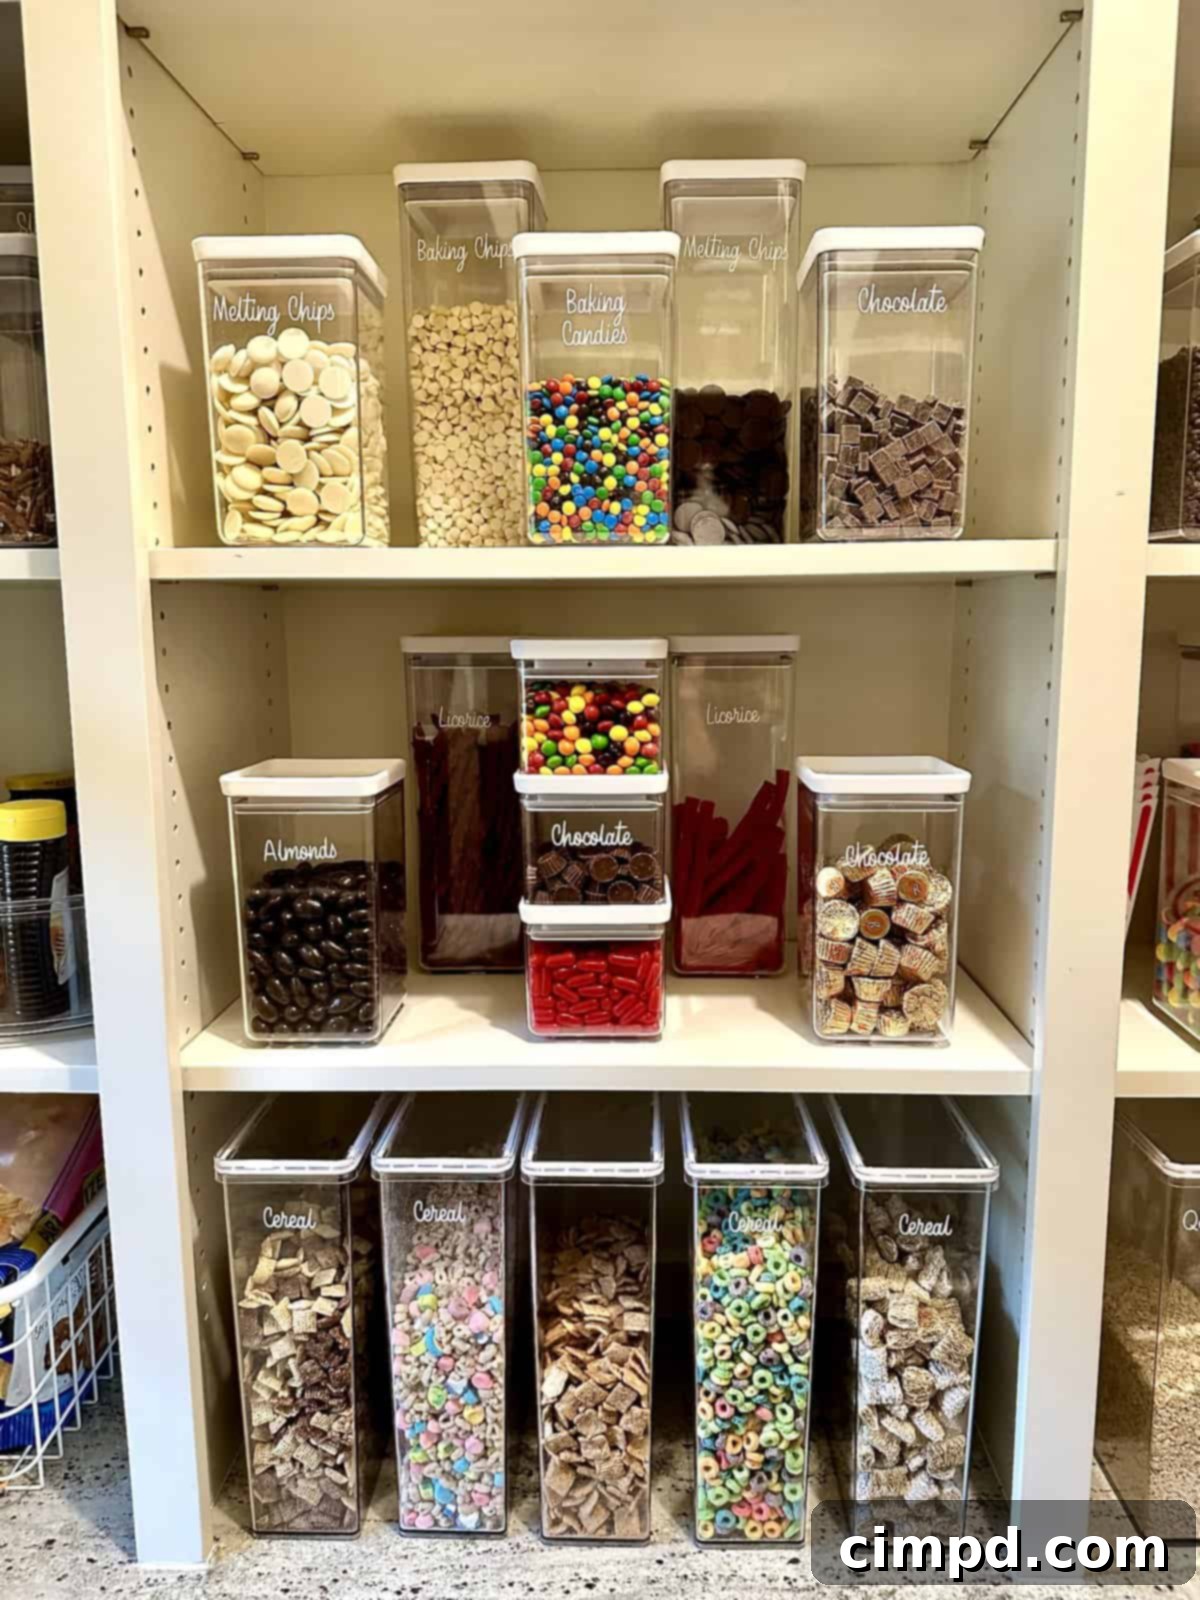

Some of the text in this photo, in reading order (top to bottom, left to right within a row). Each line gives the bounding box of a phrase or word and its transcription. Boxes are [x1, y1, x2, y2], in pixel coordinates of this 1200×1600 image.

[417, 234, 468, 273] Baking
[683, 232, 789, 273] Melting Chips
[566, 283, 627, 327] Baking
[857, 283, 948, 314] Chocolate
[213, 290, 335, 337] Melting Chips
[562, 319, 628, 346] Candies
[438, 706, 492, 729] Licorice
[706, 703, 760, 725] Licorice
[551, 820, 634, 847] Chocolate
[263, 836, 338, 862] Almonds
[843, 840, 930, 867] Chocolate
[263, 1206, 317, 1230] Cereal
[413, 1199, 467, 1224] Cereal
[727, 1210, 783, 1233] Cereal
[899, 1212, 953, 1237] Cereal
